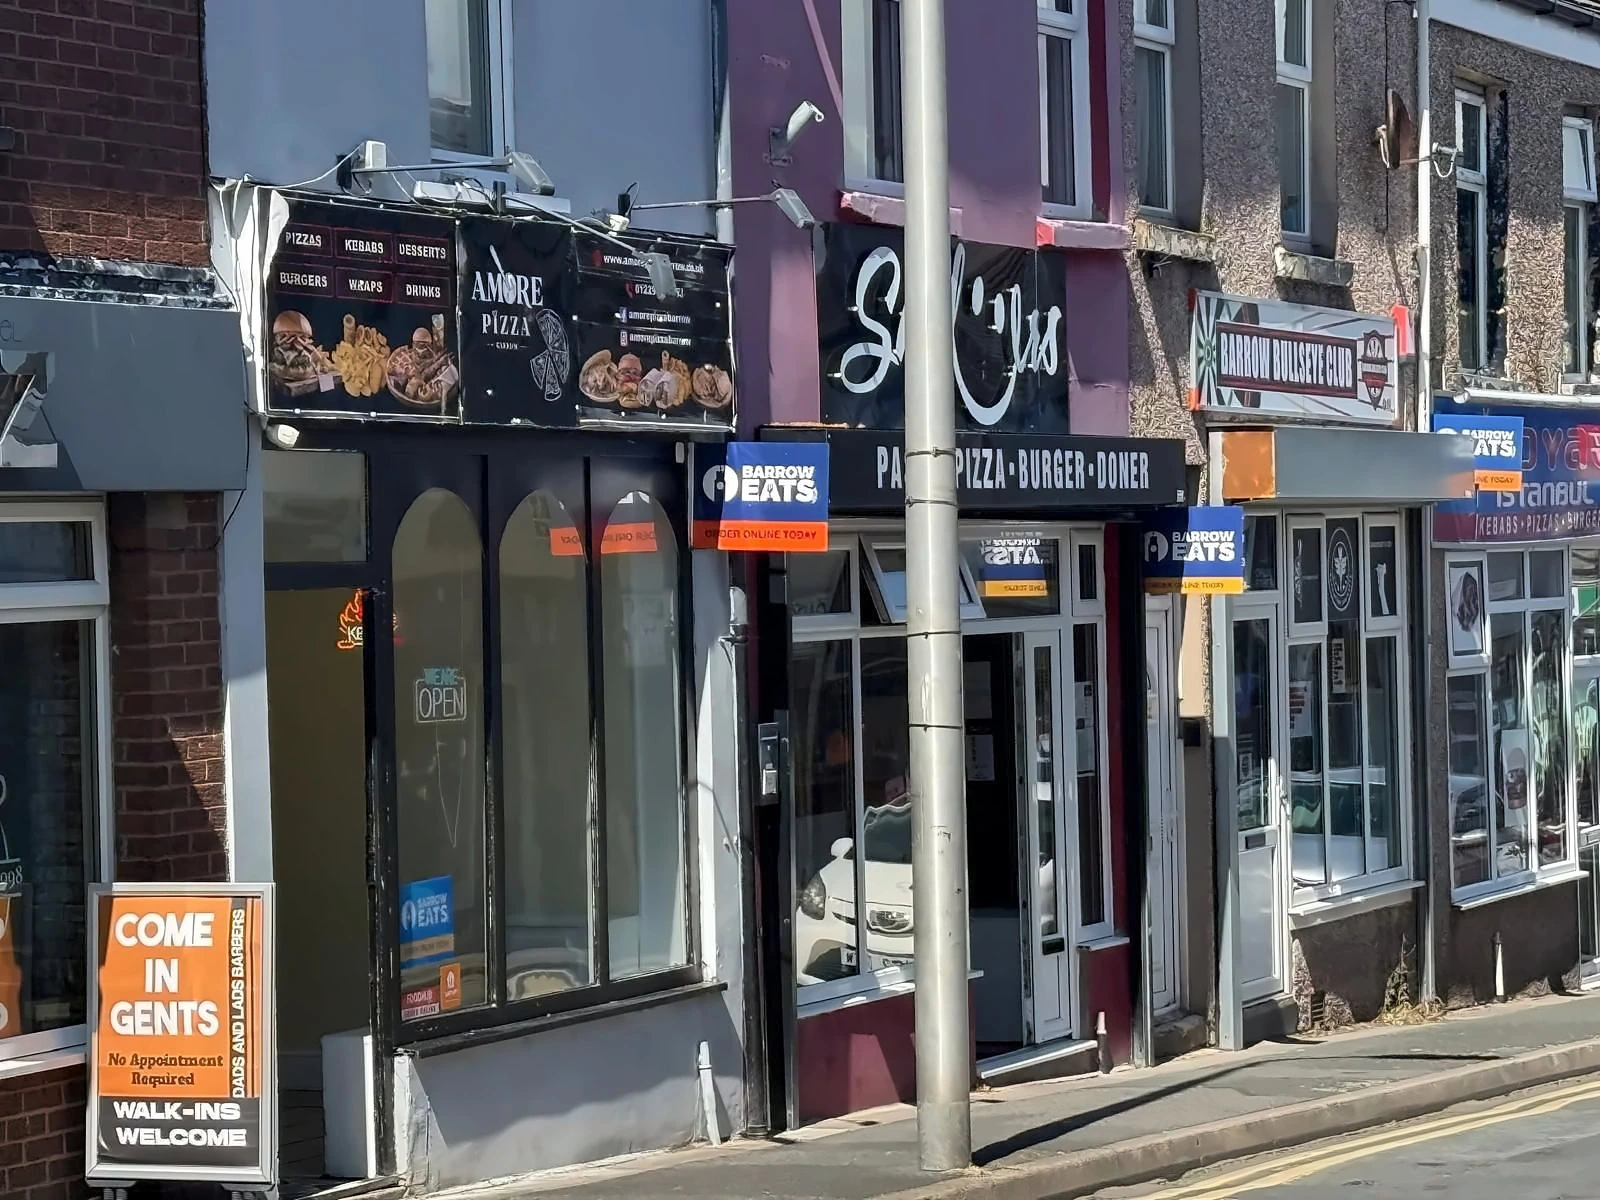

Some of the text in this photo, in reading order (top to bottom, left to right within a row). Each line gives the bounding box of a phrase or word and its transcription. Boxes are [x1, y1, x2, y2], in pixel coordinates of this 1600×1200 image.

[285, 231, 446, 260] PIZZAS KEBABS DESSERTS
[279, 271, 441, 299] BURGERS WRAPS DRINKS
[472, 271, 544, 309] AMORE
[482, 309, 530, 337] PIZZA
[1219, 332, 1353, 388] BARROW BULLSEYE CLUB
[1471, 430, 1514, 440] ARROW
[1473, 440, 1516, 458] ATS
[741, 465, 815, 479] BARROW
[956, 448, 1149, 490] PIZZA BURGER DONER
[741, 478, 818, 503] EATS
[705, 529, 817, 539] ORDER ONLINE TODAY
[1479, 514, 1518, 536] KEBABS
[1526, 511, 1560, 534] PIZZAS
[1172, 531, 1235, 542] BARROW
[1172, 542, 1235, 561] EATS
[419, 687, 464, 718] OPEN
[417, 905, 449, 928] EATS
[114, 912, 215, 947] COME
[144, 958, 179, 993] IN
[231, 908, 245, 1098] DADS AND LADS BARBERS
[110, 1000, 220, 1037] GENTS
[108, 1052, 223, 1072] No Appointment
[131, 1072, 195, 1088] Required
[113, 1101, 241, 1120] WALK-INS
[116, 1127, 247, 1147] WELCOME
